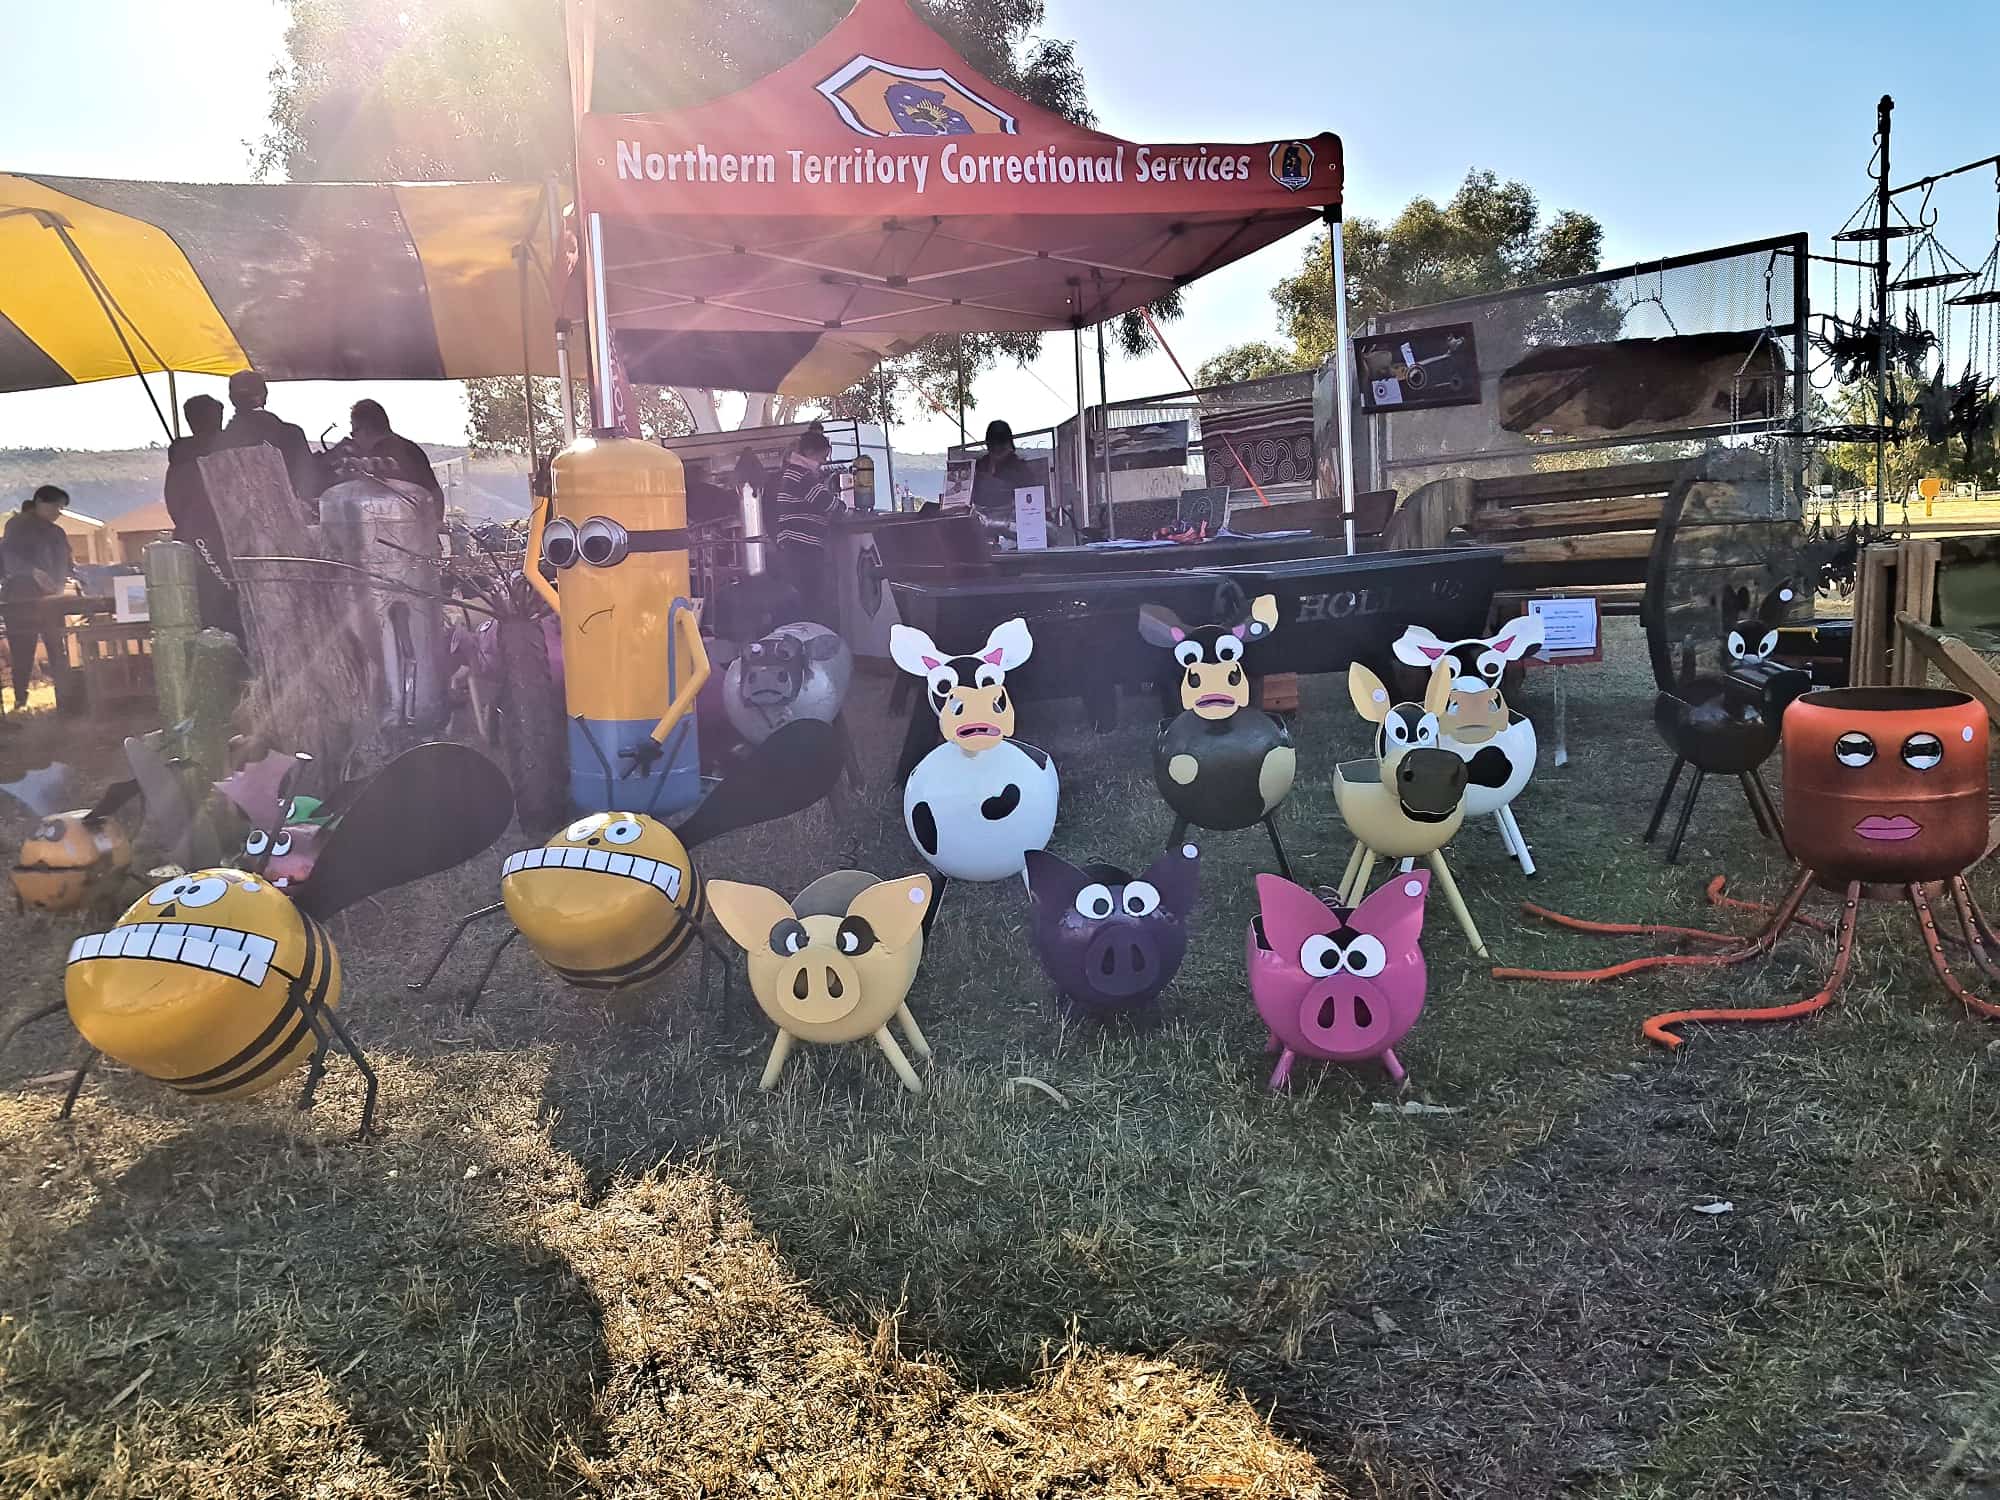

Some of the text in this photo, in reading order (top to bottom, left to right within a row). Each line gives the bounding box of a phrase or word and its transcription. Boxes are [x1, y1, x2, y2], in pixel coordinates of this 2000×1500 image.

[616, 140, 1250, 193] Northern Territory Correctional Services
